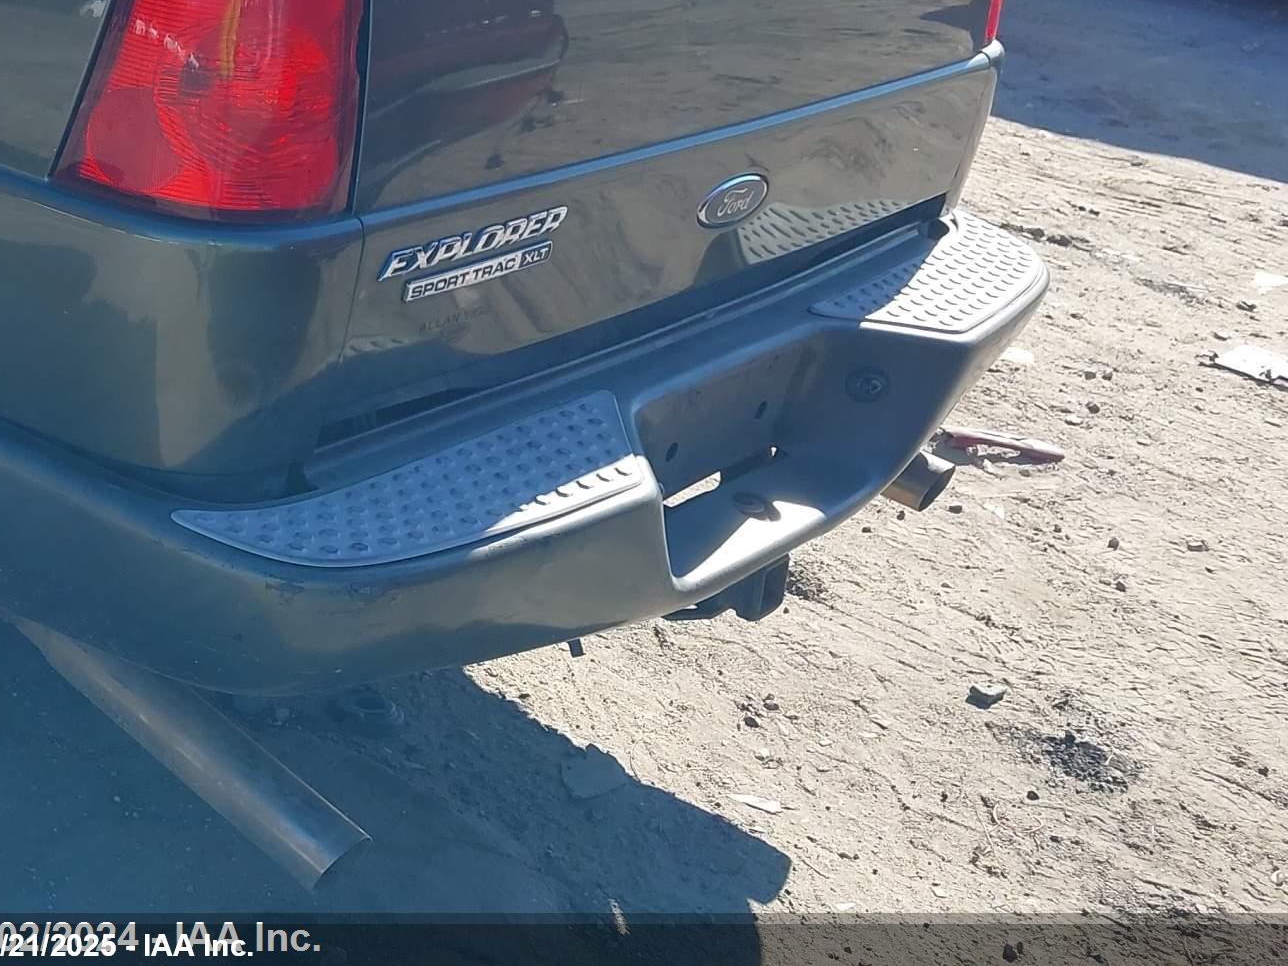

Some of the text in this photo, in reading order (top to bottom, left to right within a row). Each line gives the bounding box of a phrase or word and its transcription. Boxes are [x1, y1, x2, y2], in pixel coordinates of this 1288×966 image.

[717, 188, 754, 217] Ford
[378, 206, 568, 282] EXPLORER
[410, 246, 551, 300] SPORT TRAC XLT
